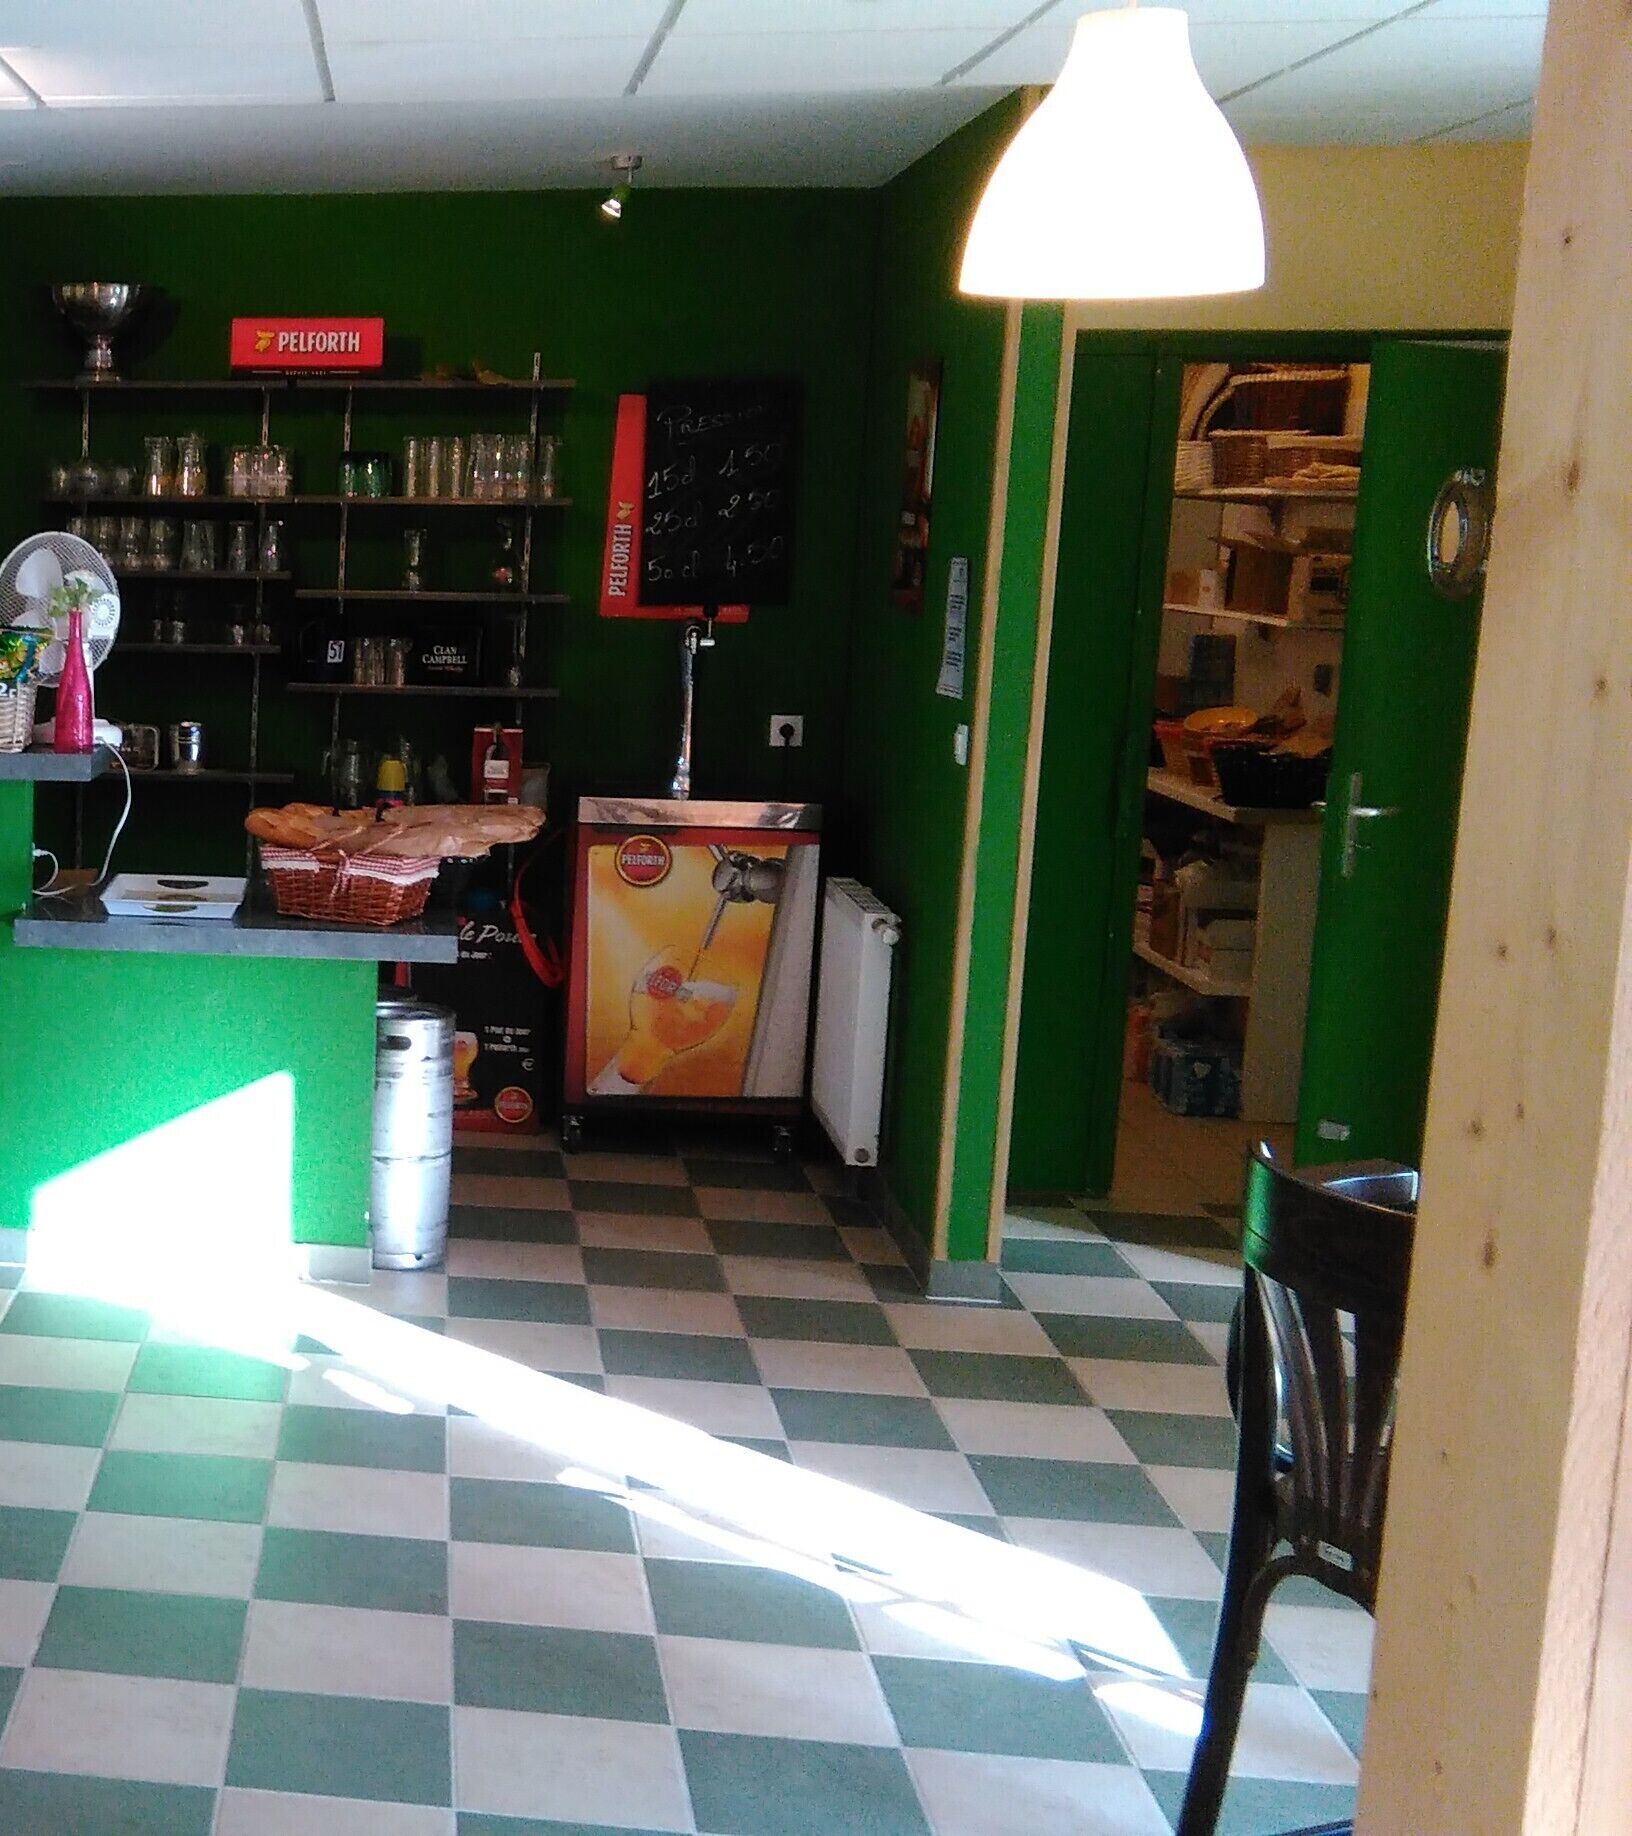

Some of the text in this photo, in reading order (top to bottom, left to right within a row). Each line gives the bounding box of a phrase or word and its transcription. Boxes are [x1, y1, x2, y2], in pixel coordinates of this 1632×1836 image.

[277, 331, 360, 352] PELFORTH
[608, 523, 633, 597] PELFORTH
[433, 645, 458, 655] CLAN
[422, 653, 468, 664] CAMPBELL
[621, 854, 666, 866] PELFORTH
